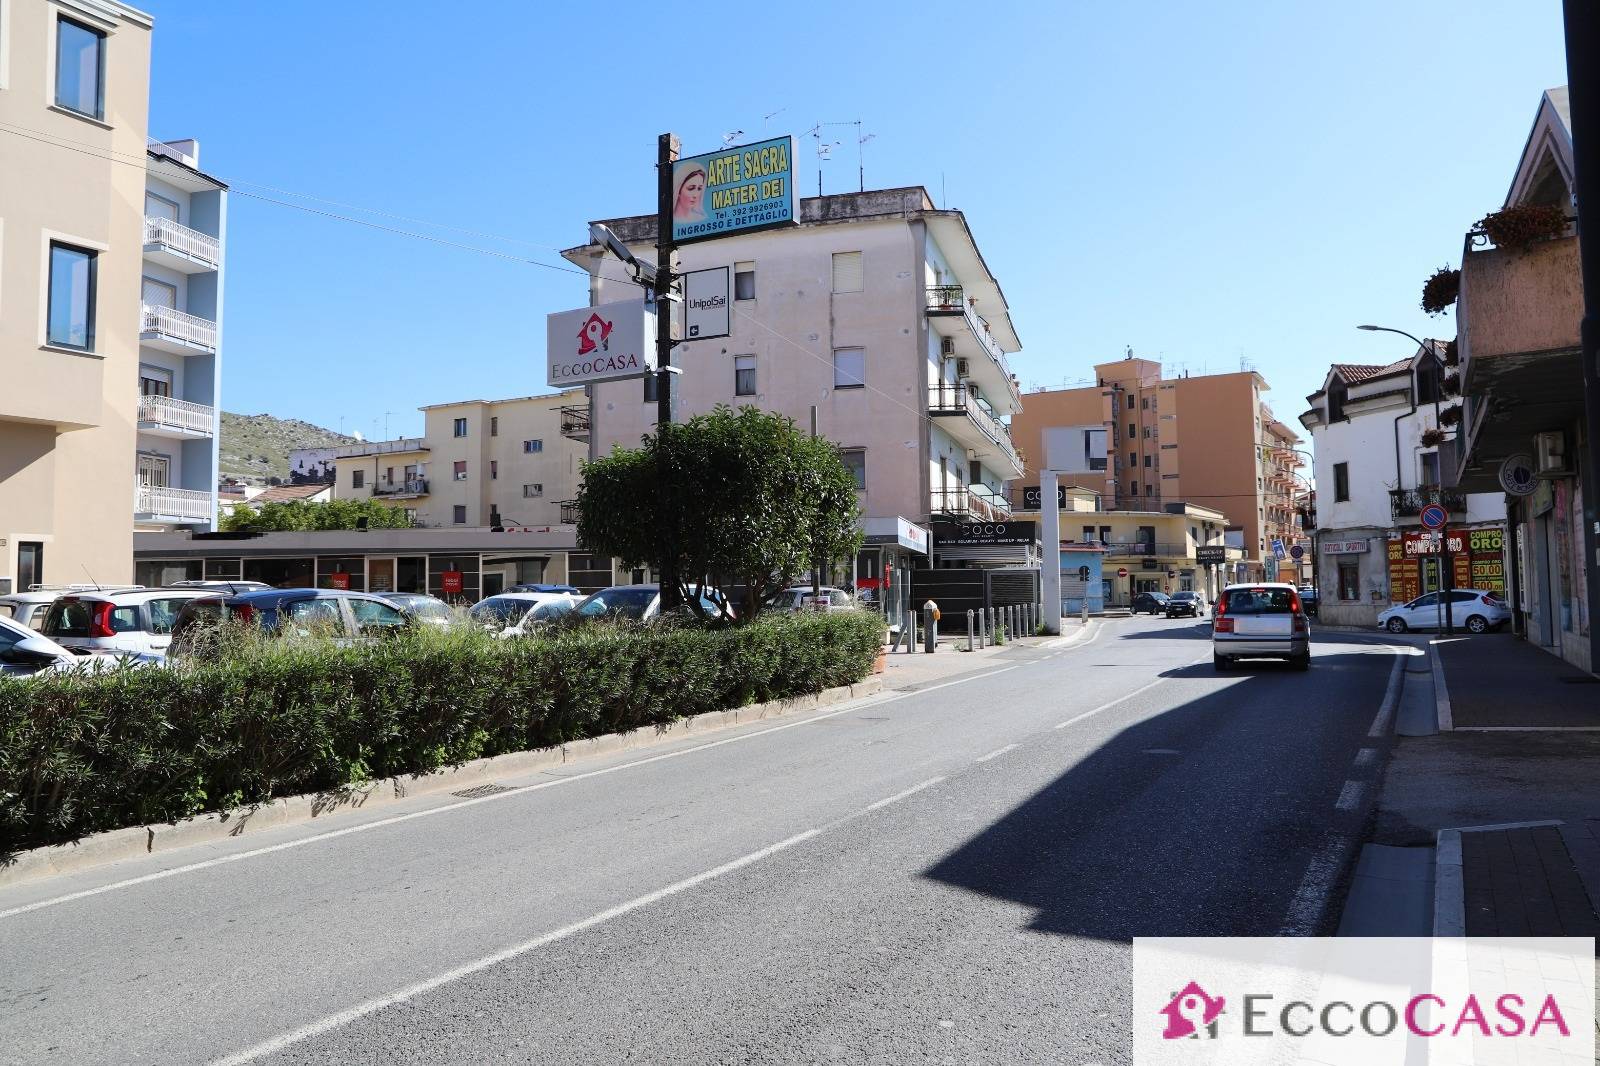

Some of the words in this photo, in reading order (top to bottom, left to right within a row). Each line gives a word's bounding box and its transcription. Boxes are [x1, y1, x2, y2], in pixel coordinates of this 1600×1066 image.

[707, 154, 741, 188] ARTE
[744, 144, 788, 179] SACRA
[712, 183, 758, 210] MATER
[761, 178, 784, 200] DEI
[716, 211, 730, 219] Tel.
[732, 207, 748, 216] 392
[749, 200, 784, 214] 9926903
[677, 221, 724, 236] INGROSSO
[727, 218, 732, 228] E
[735, 208, 788, 225] DETTAGLIO
[689, 295, 726, 311] UnipolSai
[962, 524, 1006, 536] COCO
[1470, 529, 1502, 540] COMPRO
[1470, 538, 1502, 549] ORO
